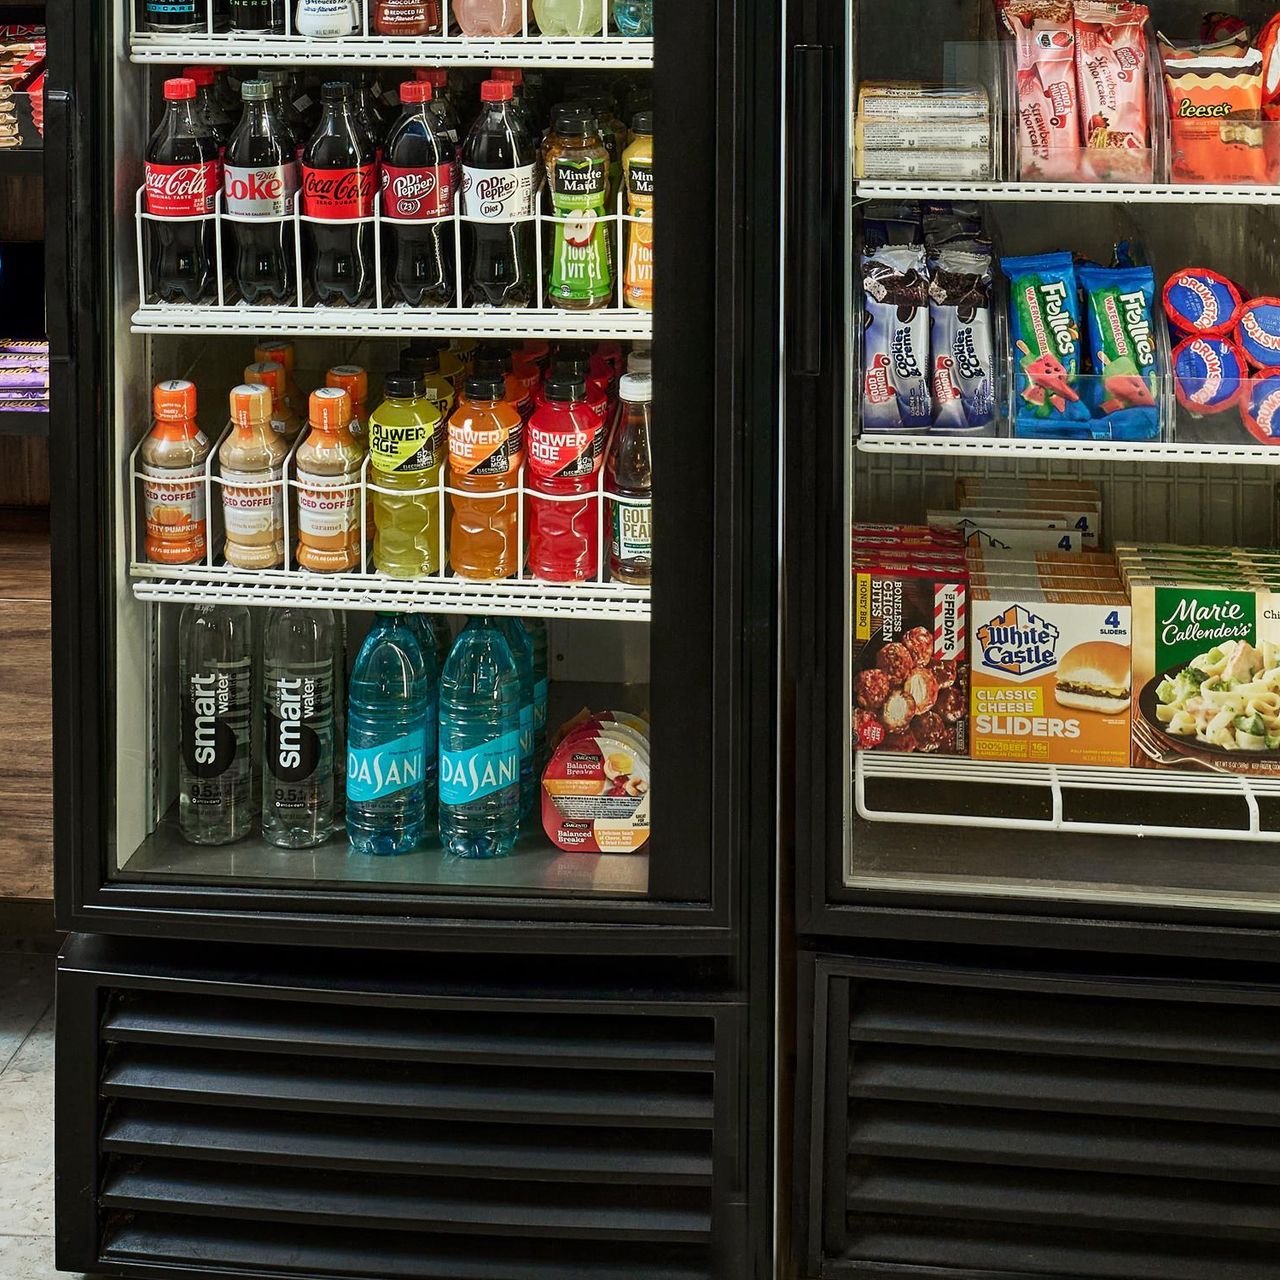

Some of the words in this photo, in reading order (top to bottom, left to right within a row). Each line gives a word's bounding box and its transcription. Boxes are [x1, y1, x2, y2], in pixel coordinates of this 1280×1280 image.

[1177, 99, 1232, 117] Reese's
[145, 165, 209, 195] Coca-Cola
[224, 170, 282, 200] Coke
[559, 169, 602, 180] Minute
[564, 180, 596, 191] Maid
[485, 204, 498, 214] Diet
[531, 432, 587, 447] POWER
[531, 444, 559, 461] ADE
[300, 498, 318, 508] ICED
[872, 580, 882, 618] BITES
[882, 581, 893, 642] CHICKEN
[894, 581, 902, 632] BONELESS
[1104, 611, 1120, 628] 4
[1162, 599, 1244, 625] Marie
[943, 600, 954, 650] FRIDAYS
[988, 625, 1050, 648] White
[1162, 621, 1252, 646] Callender's
[984, 646, 1056, 665] Castle
[218, 672, 229, 714] water
[304, 678, 314, 718] water
[976, 690, 1037, 700] CLASSIC
[191, 673, 216, 765] smart
[978, 703, 1033, 713] CHEESE
[276, 678, 301, 768] smart
[976, 716, 1080, 738] SLIDERS
[348, 752, 421, 793] DASANI
[442, 753, 516, 796] DASANI
